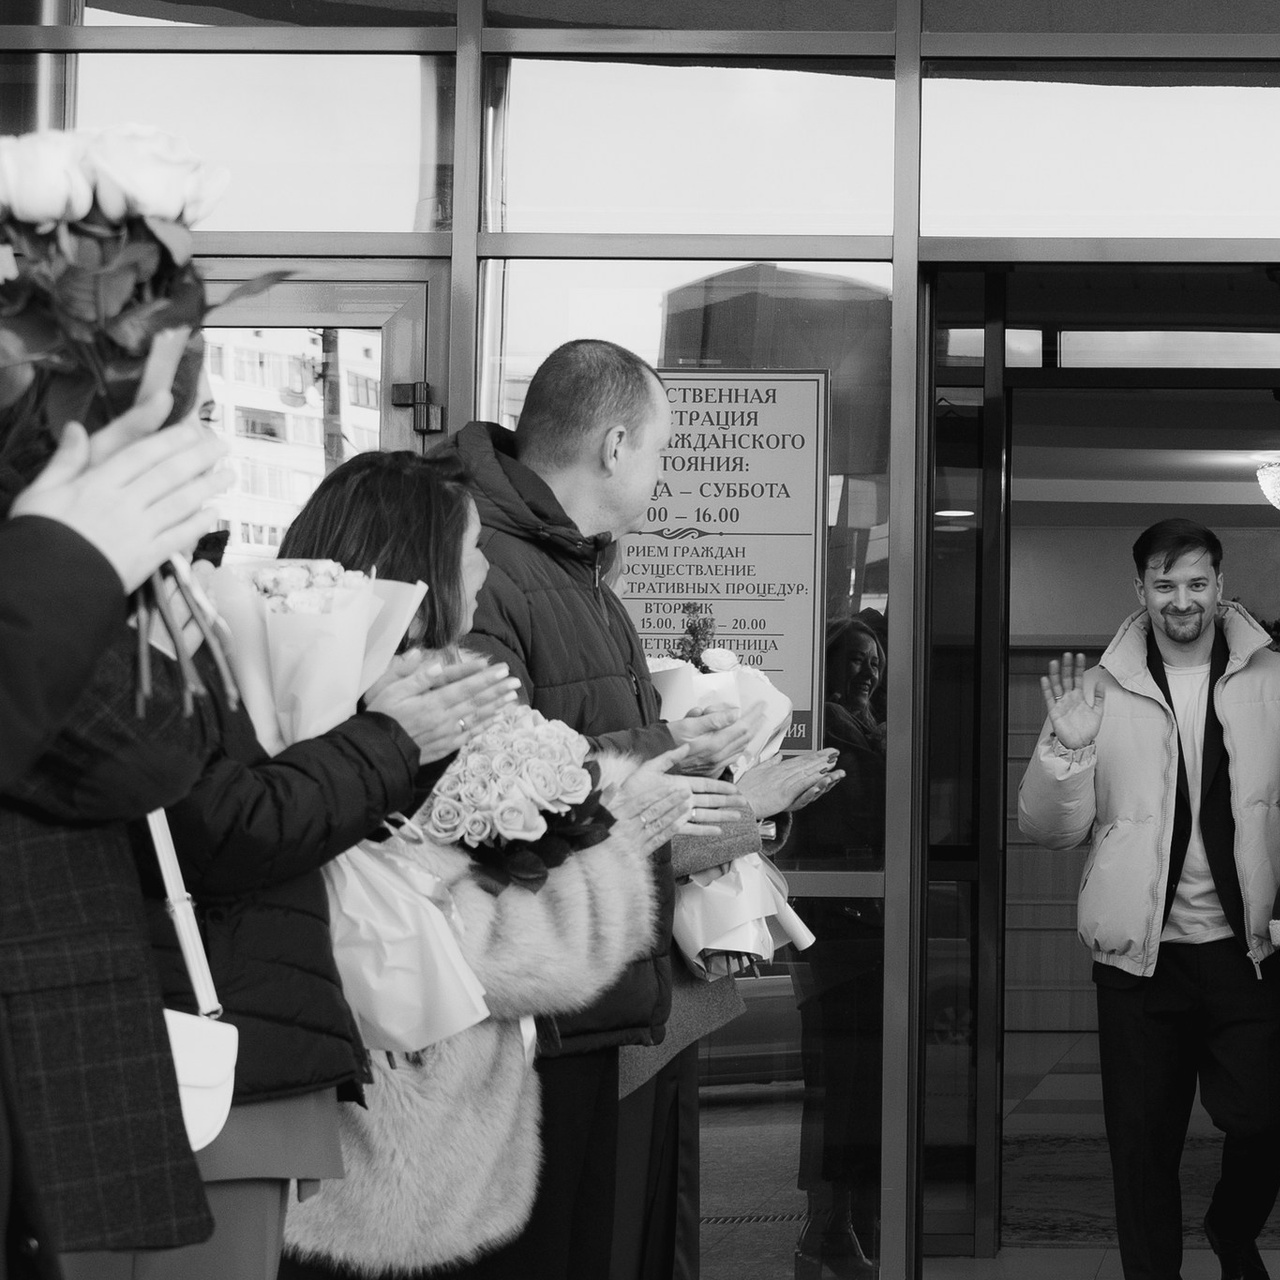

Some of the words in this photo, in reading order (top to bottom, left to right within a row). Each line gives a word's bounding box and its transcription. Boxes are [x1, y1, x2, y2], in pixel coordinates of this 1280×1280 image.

[671, 410, 759, 430] ТРАЦИЯ
[699, 482, 791, 498] СУББОТА
[694, 507, 740, 523] 16.00
[673, 546, 746, 560] ГРАЖДАН
[623, 581, 721, 595] ТРАТИВНЫХ
[725, 582, 809, 598] ПРОЦЕДУР:
[640, 617, 676, 630] 15.00,
[732, 618, 766, 630] 20.00
